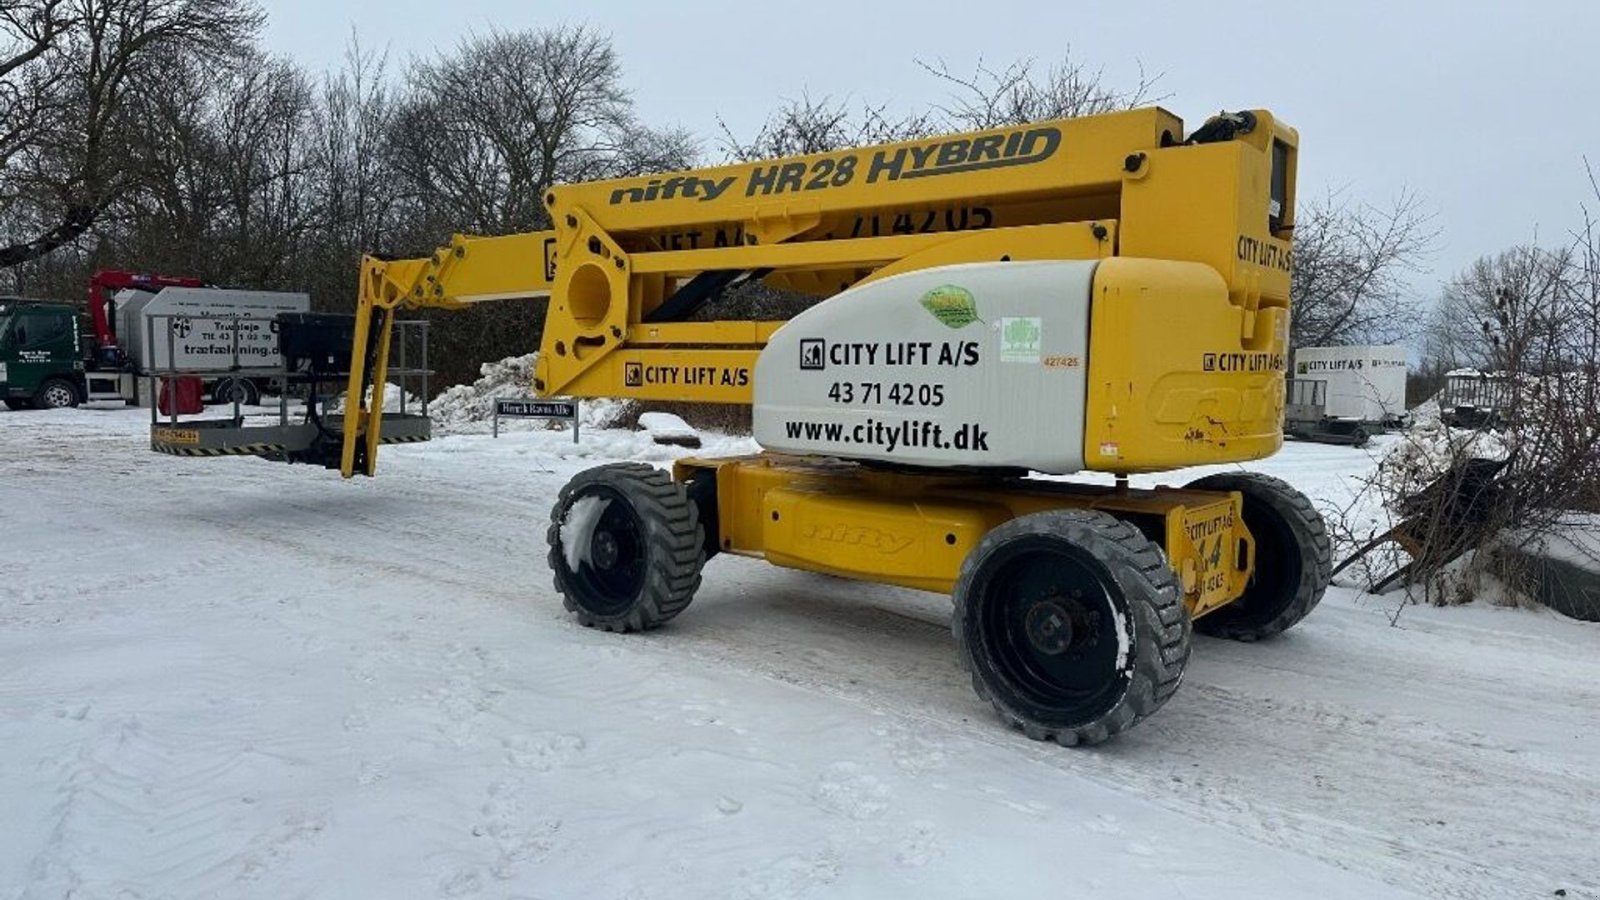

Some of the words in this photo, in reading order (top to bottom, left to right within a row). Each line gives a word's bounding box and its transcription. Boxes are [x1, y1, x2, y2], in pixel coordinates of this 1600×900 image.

[610, 176, 740, 204] nifty
[745, 155, 858, 198] HR28
[865, 128, 1062, 184] HYBRID
[1238, 235, 1258, 264] CITY
[1259, 242, 1278, 269] LIFT
[830, 343, 879, 366] CITY
[886, 342, 932, 367] LIFT
[938, 340, 980, 368] A/S
[1219, 353, 1246, 372] CITY
[1249, 353, 1267, 372] LIFT
[1309, 360, 1328, 370] CITY
[1329, 360, 1347, 370] LIFT
[1348, 359, 1363, 370] A/S
[645, 366, 679, 384] CITY
[684, 367, 717, 385] LIFT
[721, 367, 749, 387] A/S
[828, 382, 854, 404] 43
[861, 382, 881, 404] 71
[888, 382, 914, 406] 42
[918, 384, 944, 407] 05
[786, 419, 989, 452] www.citylift.dk
[802, 523, 916, 555] nifty
